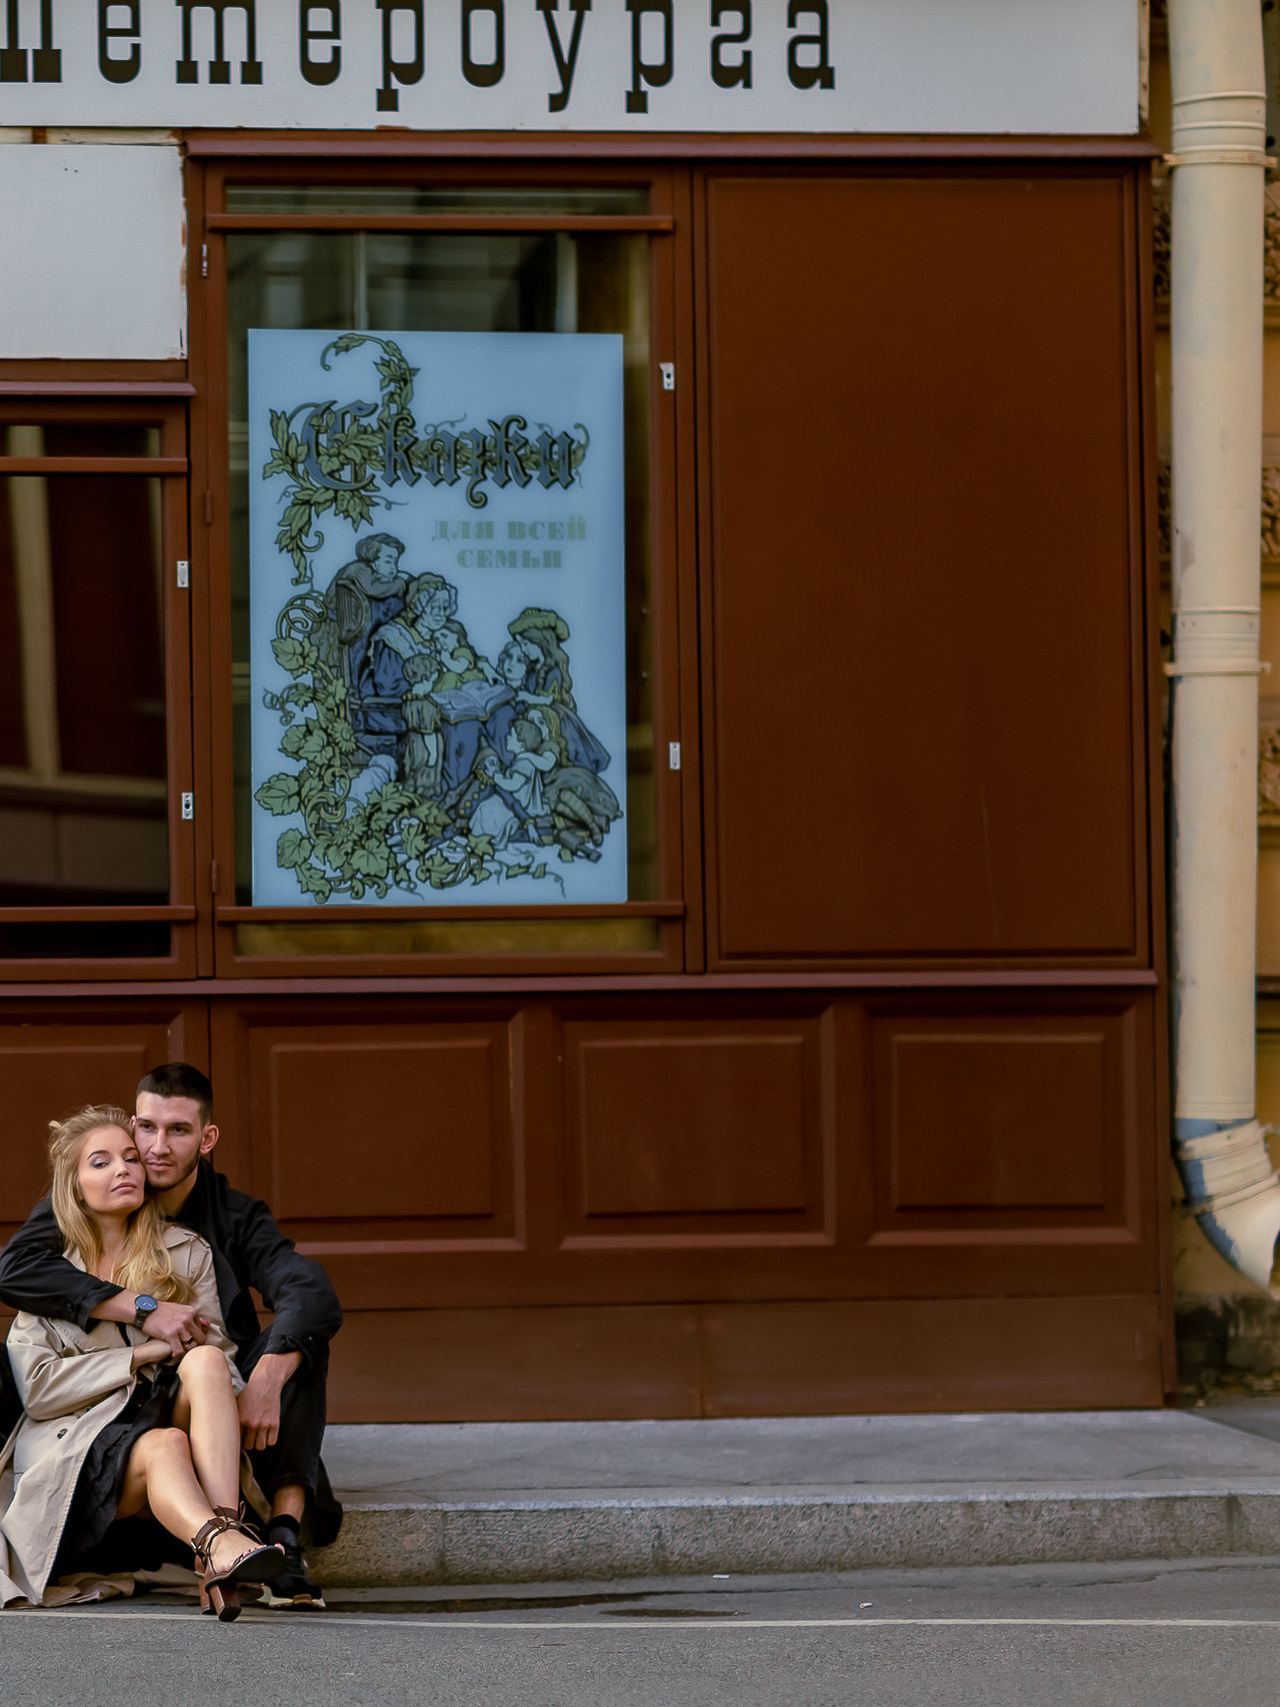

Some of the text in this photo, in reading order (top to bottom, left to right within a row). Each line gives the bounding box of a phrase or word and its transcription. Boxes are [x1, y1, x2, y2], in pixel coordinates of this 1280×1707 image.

[296, 400, 582, 508] Сказки
[431, 514, 587, 541] ДЛЯ ВСЕЙ
[456, 549, 563, 569] СЕМЬИ
